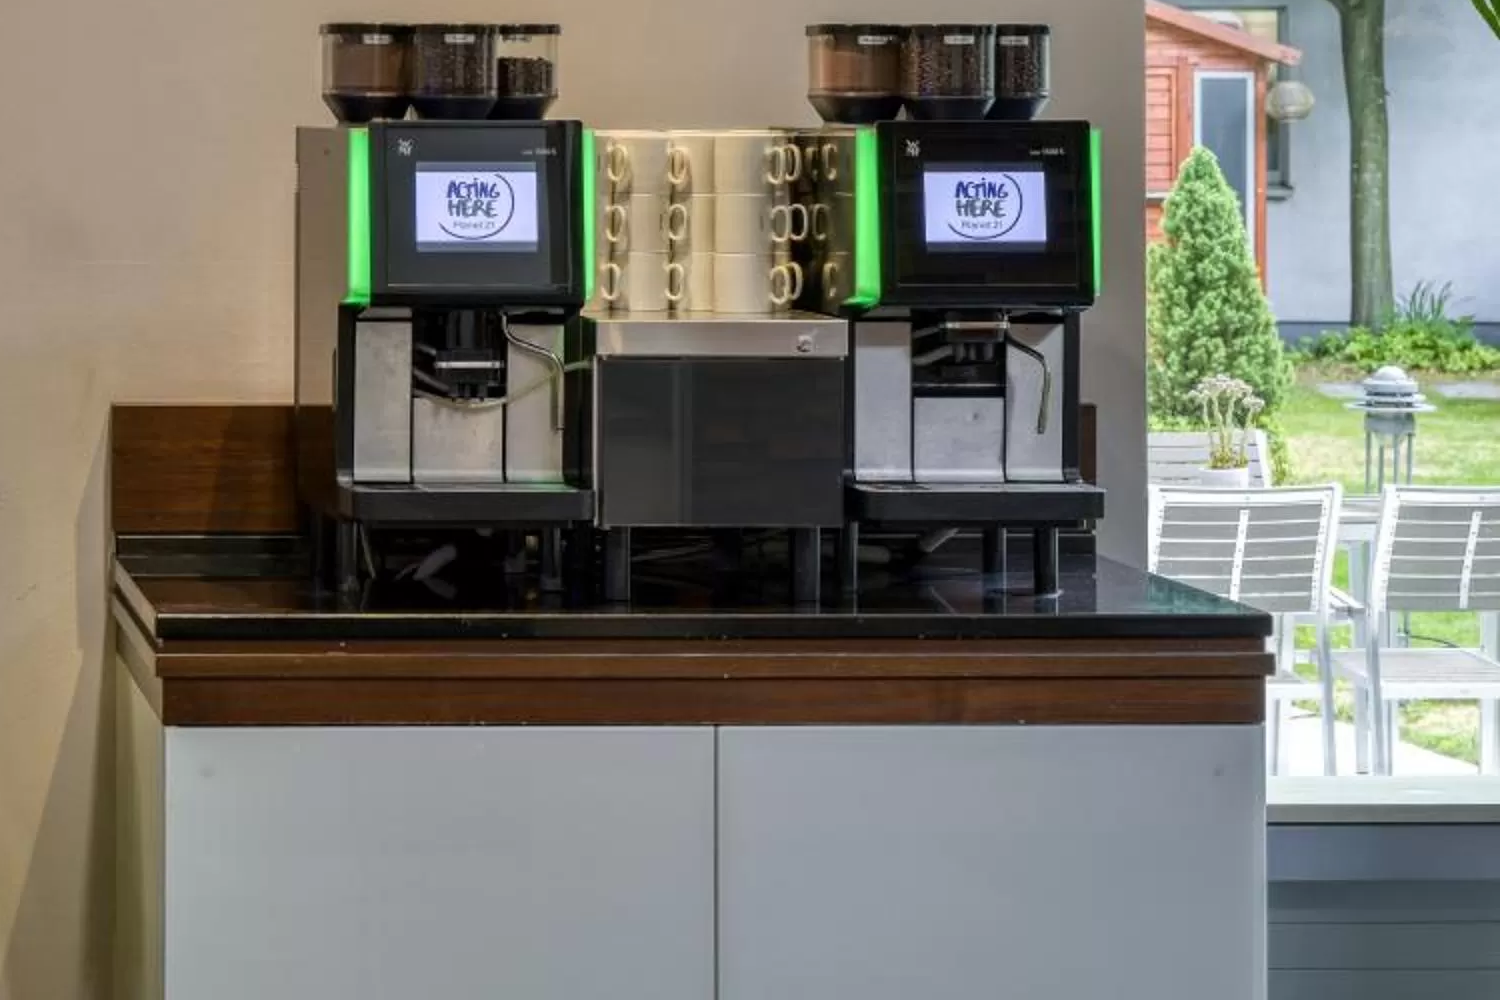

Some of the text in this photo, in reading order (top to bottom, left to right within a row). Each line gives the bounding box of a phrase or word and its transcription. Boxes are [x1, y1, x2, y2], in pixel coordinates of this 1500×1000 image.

[446, 177, 500, 199] ACTING
[955, 177, 1008, 199] ACTING
[448, 199, 499, 218] HERE
[956, 199, 1006, 218] HERE
